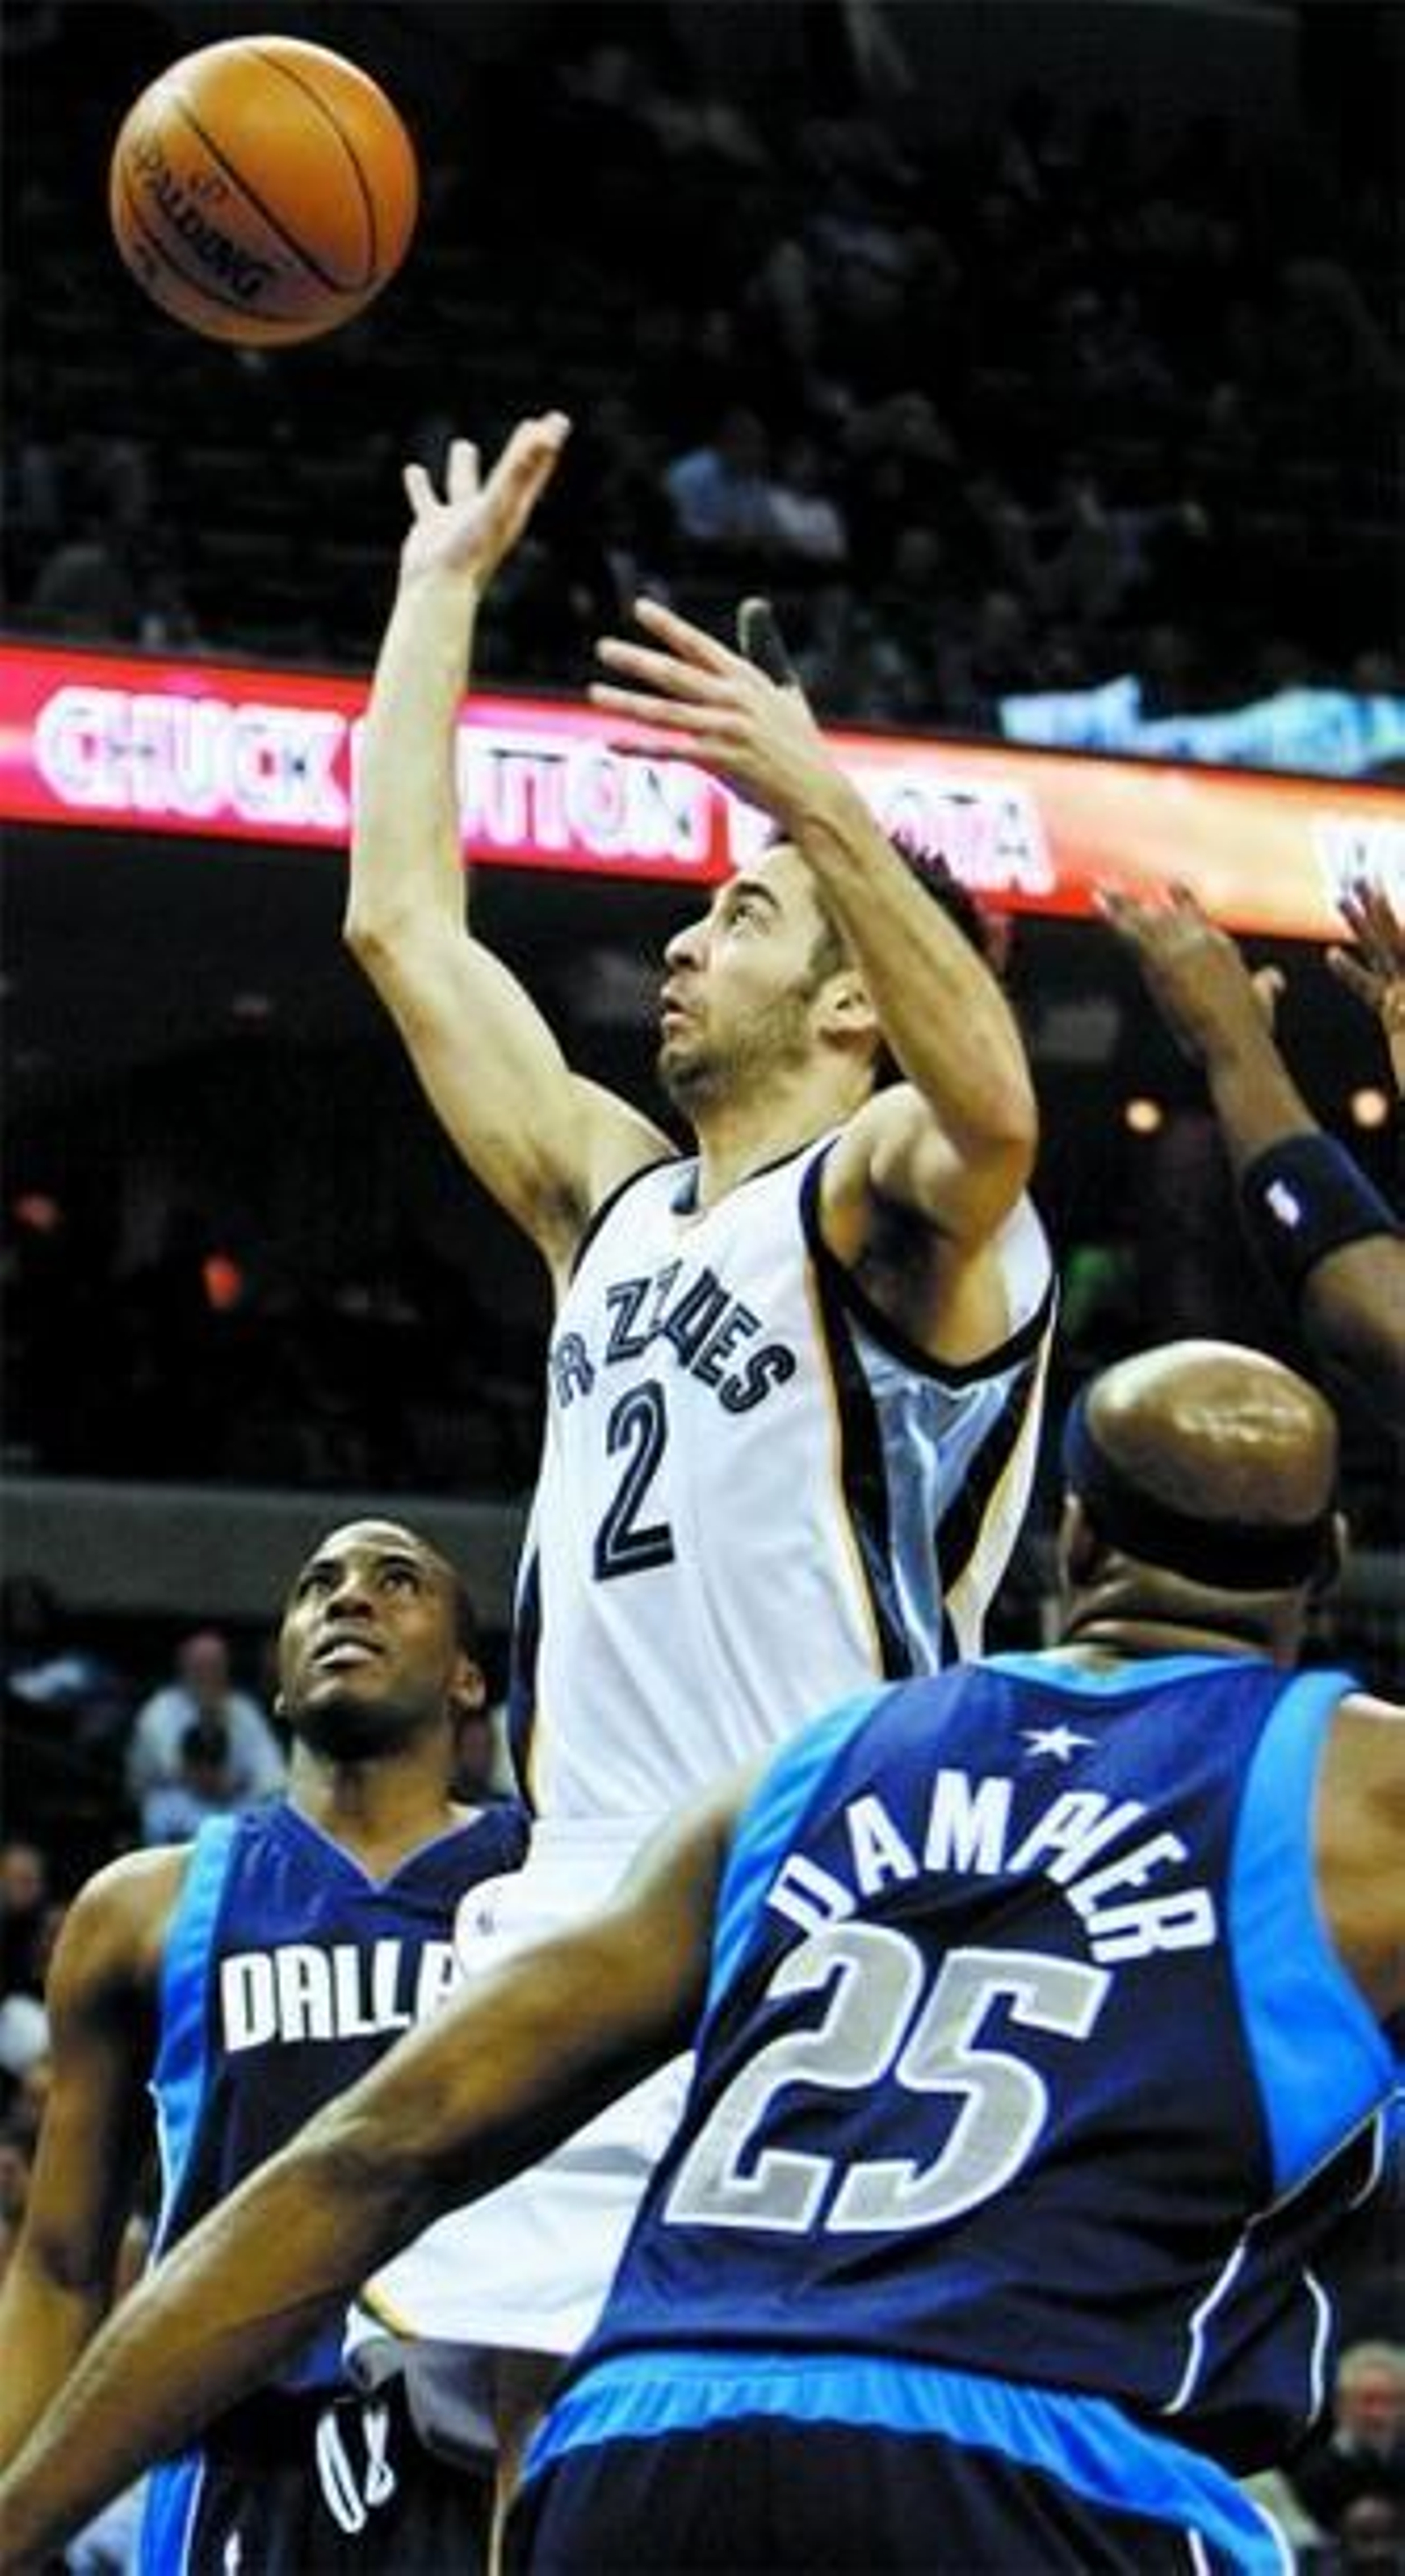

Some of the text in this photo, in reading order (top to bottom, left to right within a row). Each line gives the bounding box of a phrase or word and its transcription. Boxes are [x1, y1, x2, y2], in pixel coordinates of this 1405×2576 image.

[35, 685, 349, 827] CHUCK
[594, 1378, 676, 1582] 2
[767, 1769, 1217, 1964] DAMPIER
[662, 1921, 1113, 2233] 25
